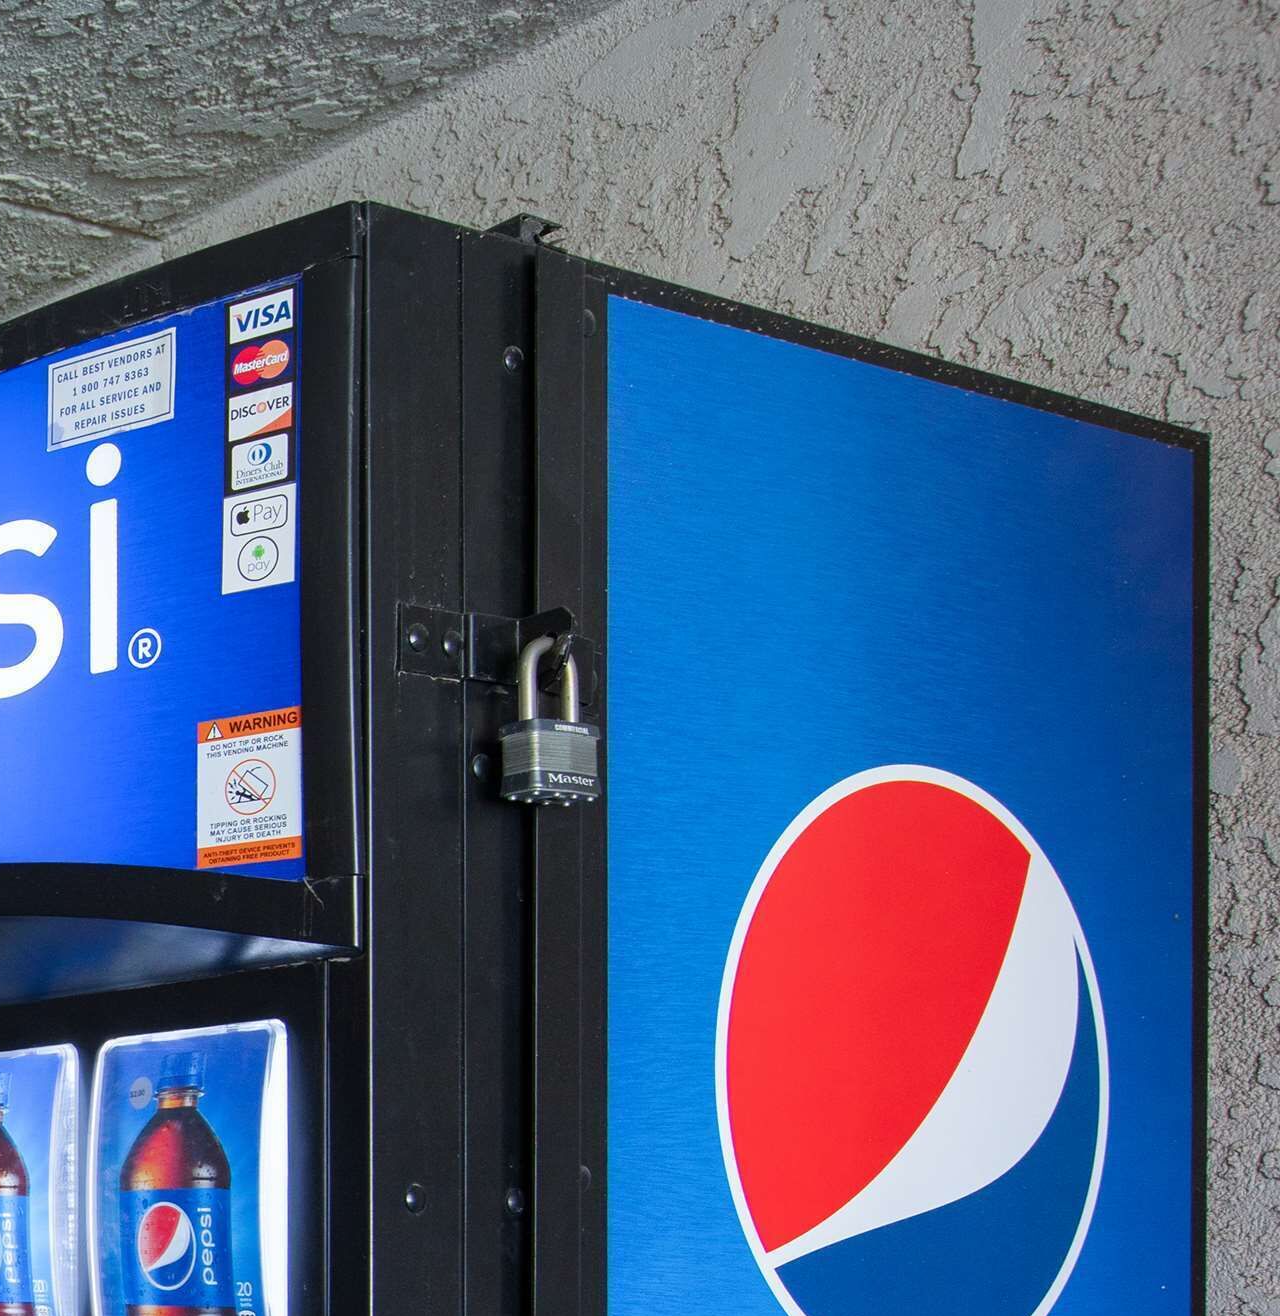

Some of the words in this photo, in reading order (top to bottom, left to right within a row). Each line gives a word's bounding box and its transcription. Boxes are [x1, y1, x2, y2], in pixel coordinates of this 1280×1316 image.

[234, 300, 291, 332] VISA
[58, 370, 78, 383] CALL
[82, 362, 105, 376] BEST
[108, 348, 152, 368] VENDORS
[155, 344, 166, 356] AT
[234, 350, 289, 376] MasterCard
[73, 388, 77, 396] 1
[81, 380, 99, 394] 800
[103, 375, 121, 387] 747
[124, 368, 149, 381] 8363
[60, 405, 77, 417] FOR
[80, 400, 96, 412] ALL
[100, 388, 140, 406] SERVICE
[142, 382, 162, 395] AND
[230, 396, 289, 420] DISCOVER
[74, 415, 107, 431] REPAIR
[111, 404, 145, 421] ISSUES
[236, 468, 262, 480] Diners
[263, 460, 284, 472] Club
[254, 504, 282, 524] Pay
[247, 559, 270, 574] pay
[229, 712, 298, 734] WARNING
[206, 750, 222, 759] THIS
[224, 746, 254, 757] VENDING
[256, 740, 289, 751] MACHINE
[222, 741, 237, 750] NOT
[240, 738, 250, 748] TIP
[252, 737, 262, 745] OR
[264, 734, 284, 743] ROCK
[549, 772, 595, 787] Master
[210, 820, 238, 829] TIPPING
[240, 817, 252, 826] OR
[254, 814, 288, 824] ROCKING
[210, 828, 226, 837] MAY
[228, 824, 252, 835] CAUSE
[254, 822, 288, 831] SERIOUS
[216, 832, 241, 843] INJURY
[244, 831, 254, 840] OR
[256, 829, 282, 839] DEATH
[204, 849, 239, 859] ANTI-THEFT
[240, 846, 262, 855] DEVICE
[263, 842, 296, 852] PREVENTS
[208, 855, 242, 865] OBTAINING
[243, 852, 259, 861] FREE
[260, 850, 289, 859] PRODUCT
[0, 1212, 18, 1284] pepsi
[197, 1208, 218, 1286] pepsi
[236, 1282, 253, 1297] 20
